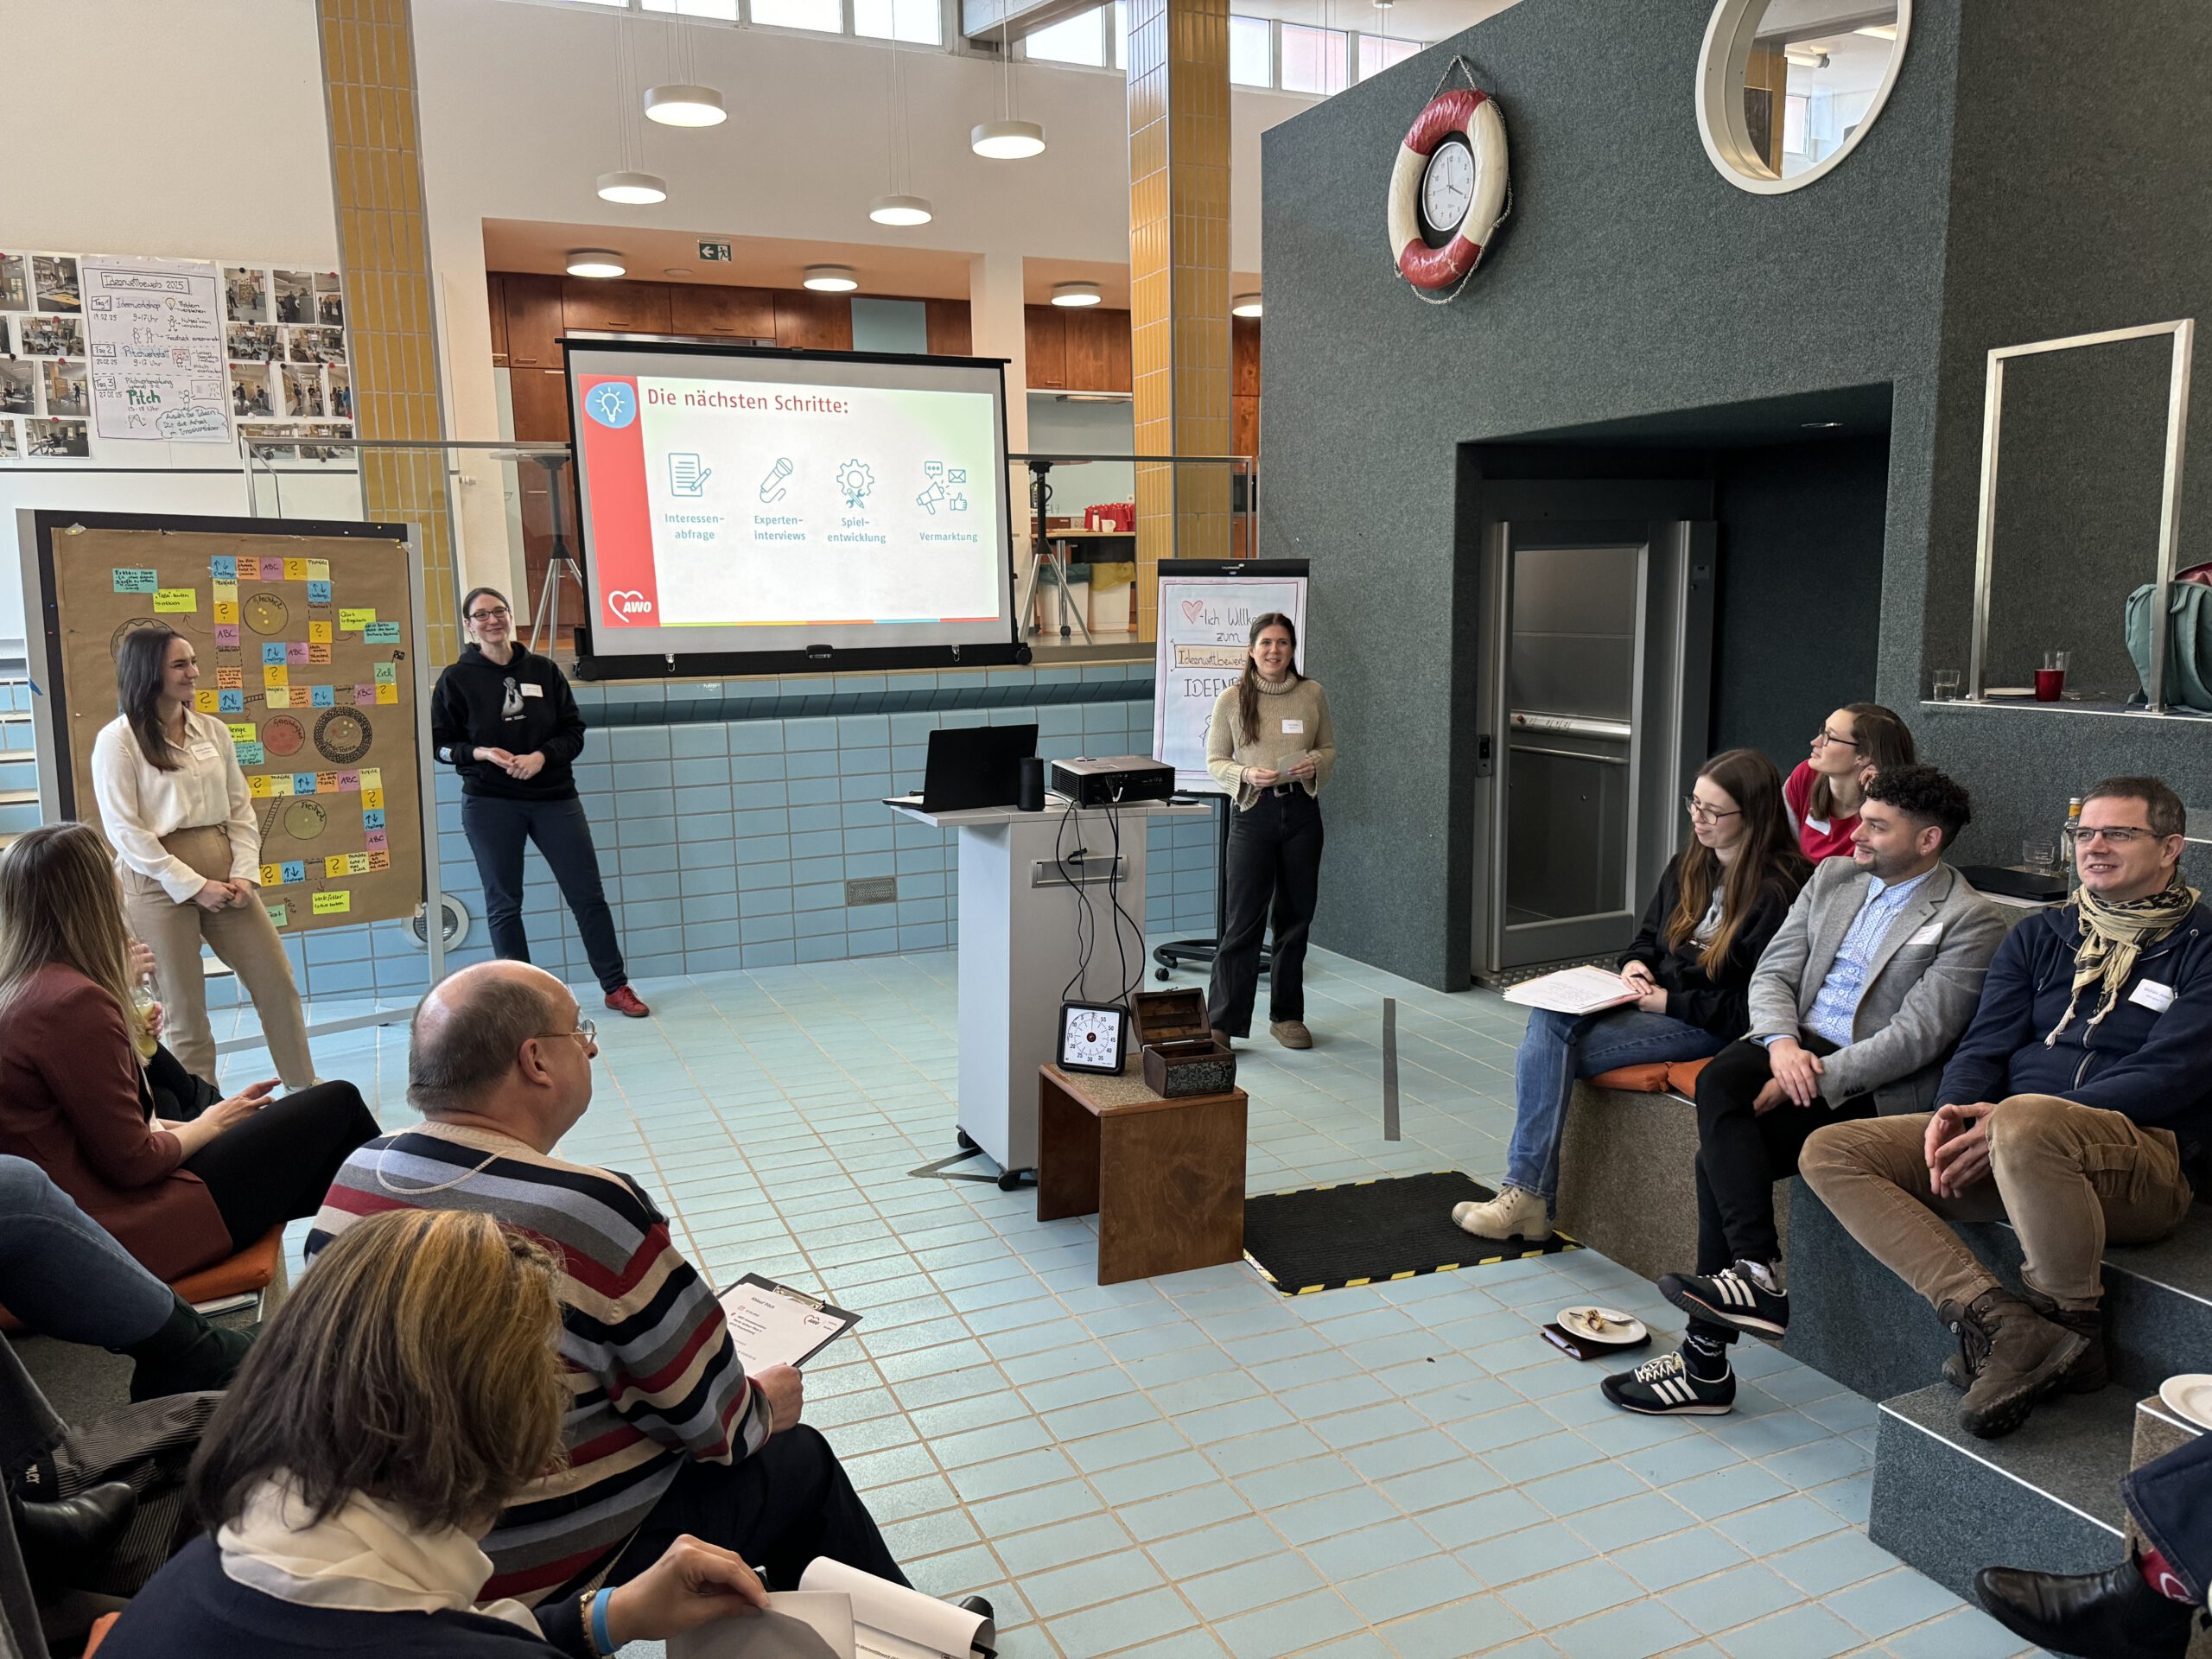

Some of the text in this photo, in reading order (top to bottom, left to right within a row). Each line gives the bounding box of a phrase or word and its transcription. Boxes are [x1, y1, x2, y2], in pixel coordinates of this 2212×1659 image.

[166, 281, 185, 290] 2025
[92, 298, 105, 309] Tag
[95, 346, 105, 356] Tag
[95, 378, 114, 389] Tag 3
[126, 389, 162, 405] Pitch
[648, 388, 849, 414] Die nächsten Schritte:
[664, 513, 725, 524] Interessen-
[754, 515, 804, 526] Experten-
[842, 518, 870, 529] Spiel-
[675, 530, 715, 541] abfrage
[754, 531, 806, 540] interviews
[827, 532, 887, 544] entwicklung
[919, 532, 978, 543] Vermarktung
[622, 601, 652, 613] AWO
[1216, 632, 1242, 643] zum
[376, 668, 393, 677] Ziel
[357, 689, 373, 698] ABC
